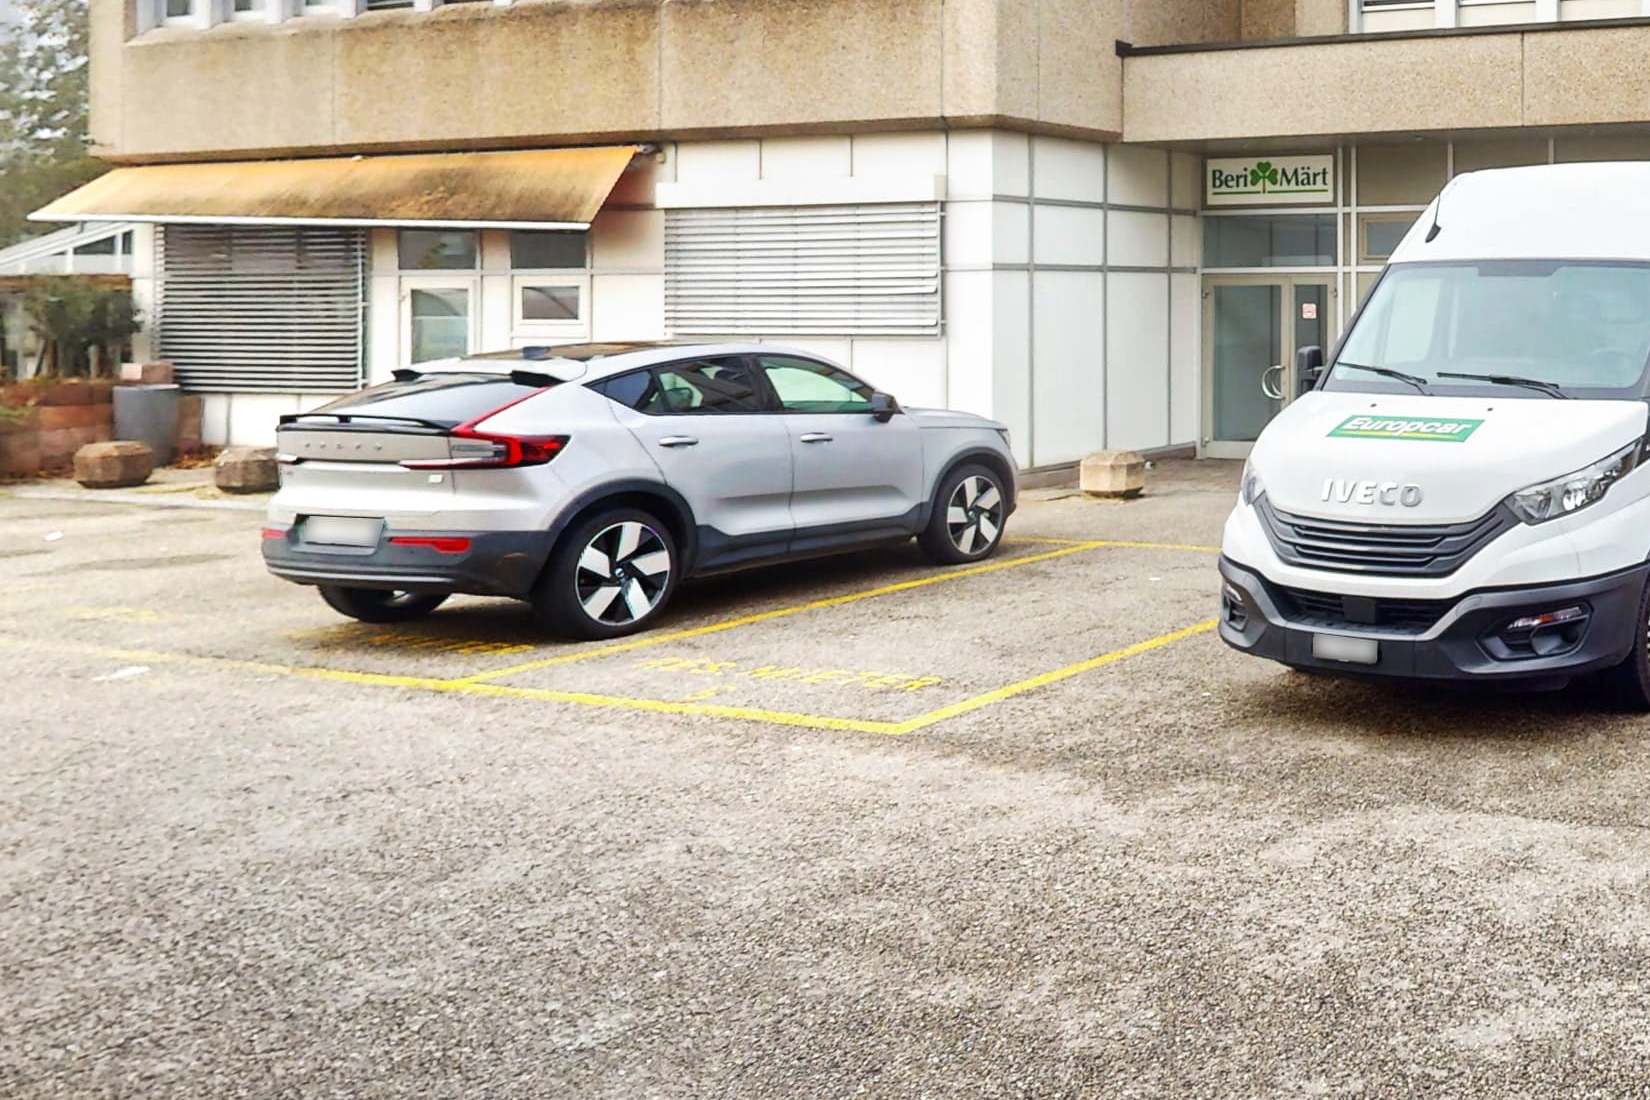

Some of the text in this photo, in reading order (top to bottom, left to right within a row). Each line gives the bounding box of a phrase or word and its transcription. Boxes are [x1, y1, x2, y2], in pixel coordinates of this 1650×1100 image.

[1211, 165, 1329, 189] Beri Märt
[1342, 417, 1473, 436] Europcar
[1321, 478, 1424, 507] IVECO
